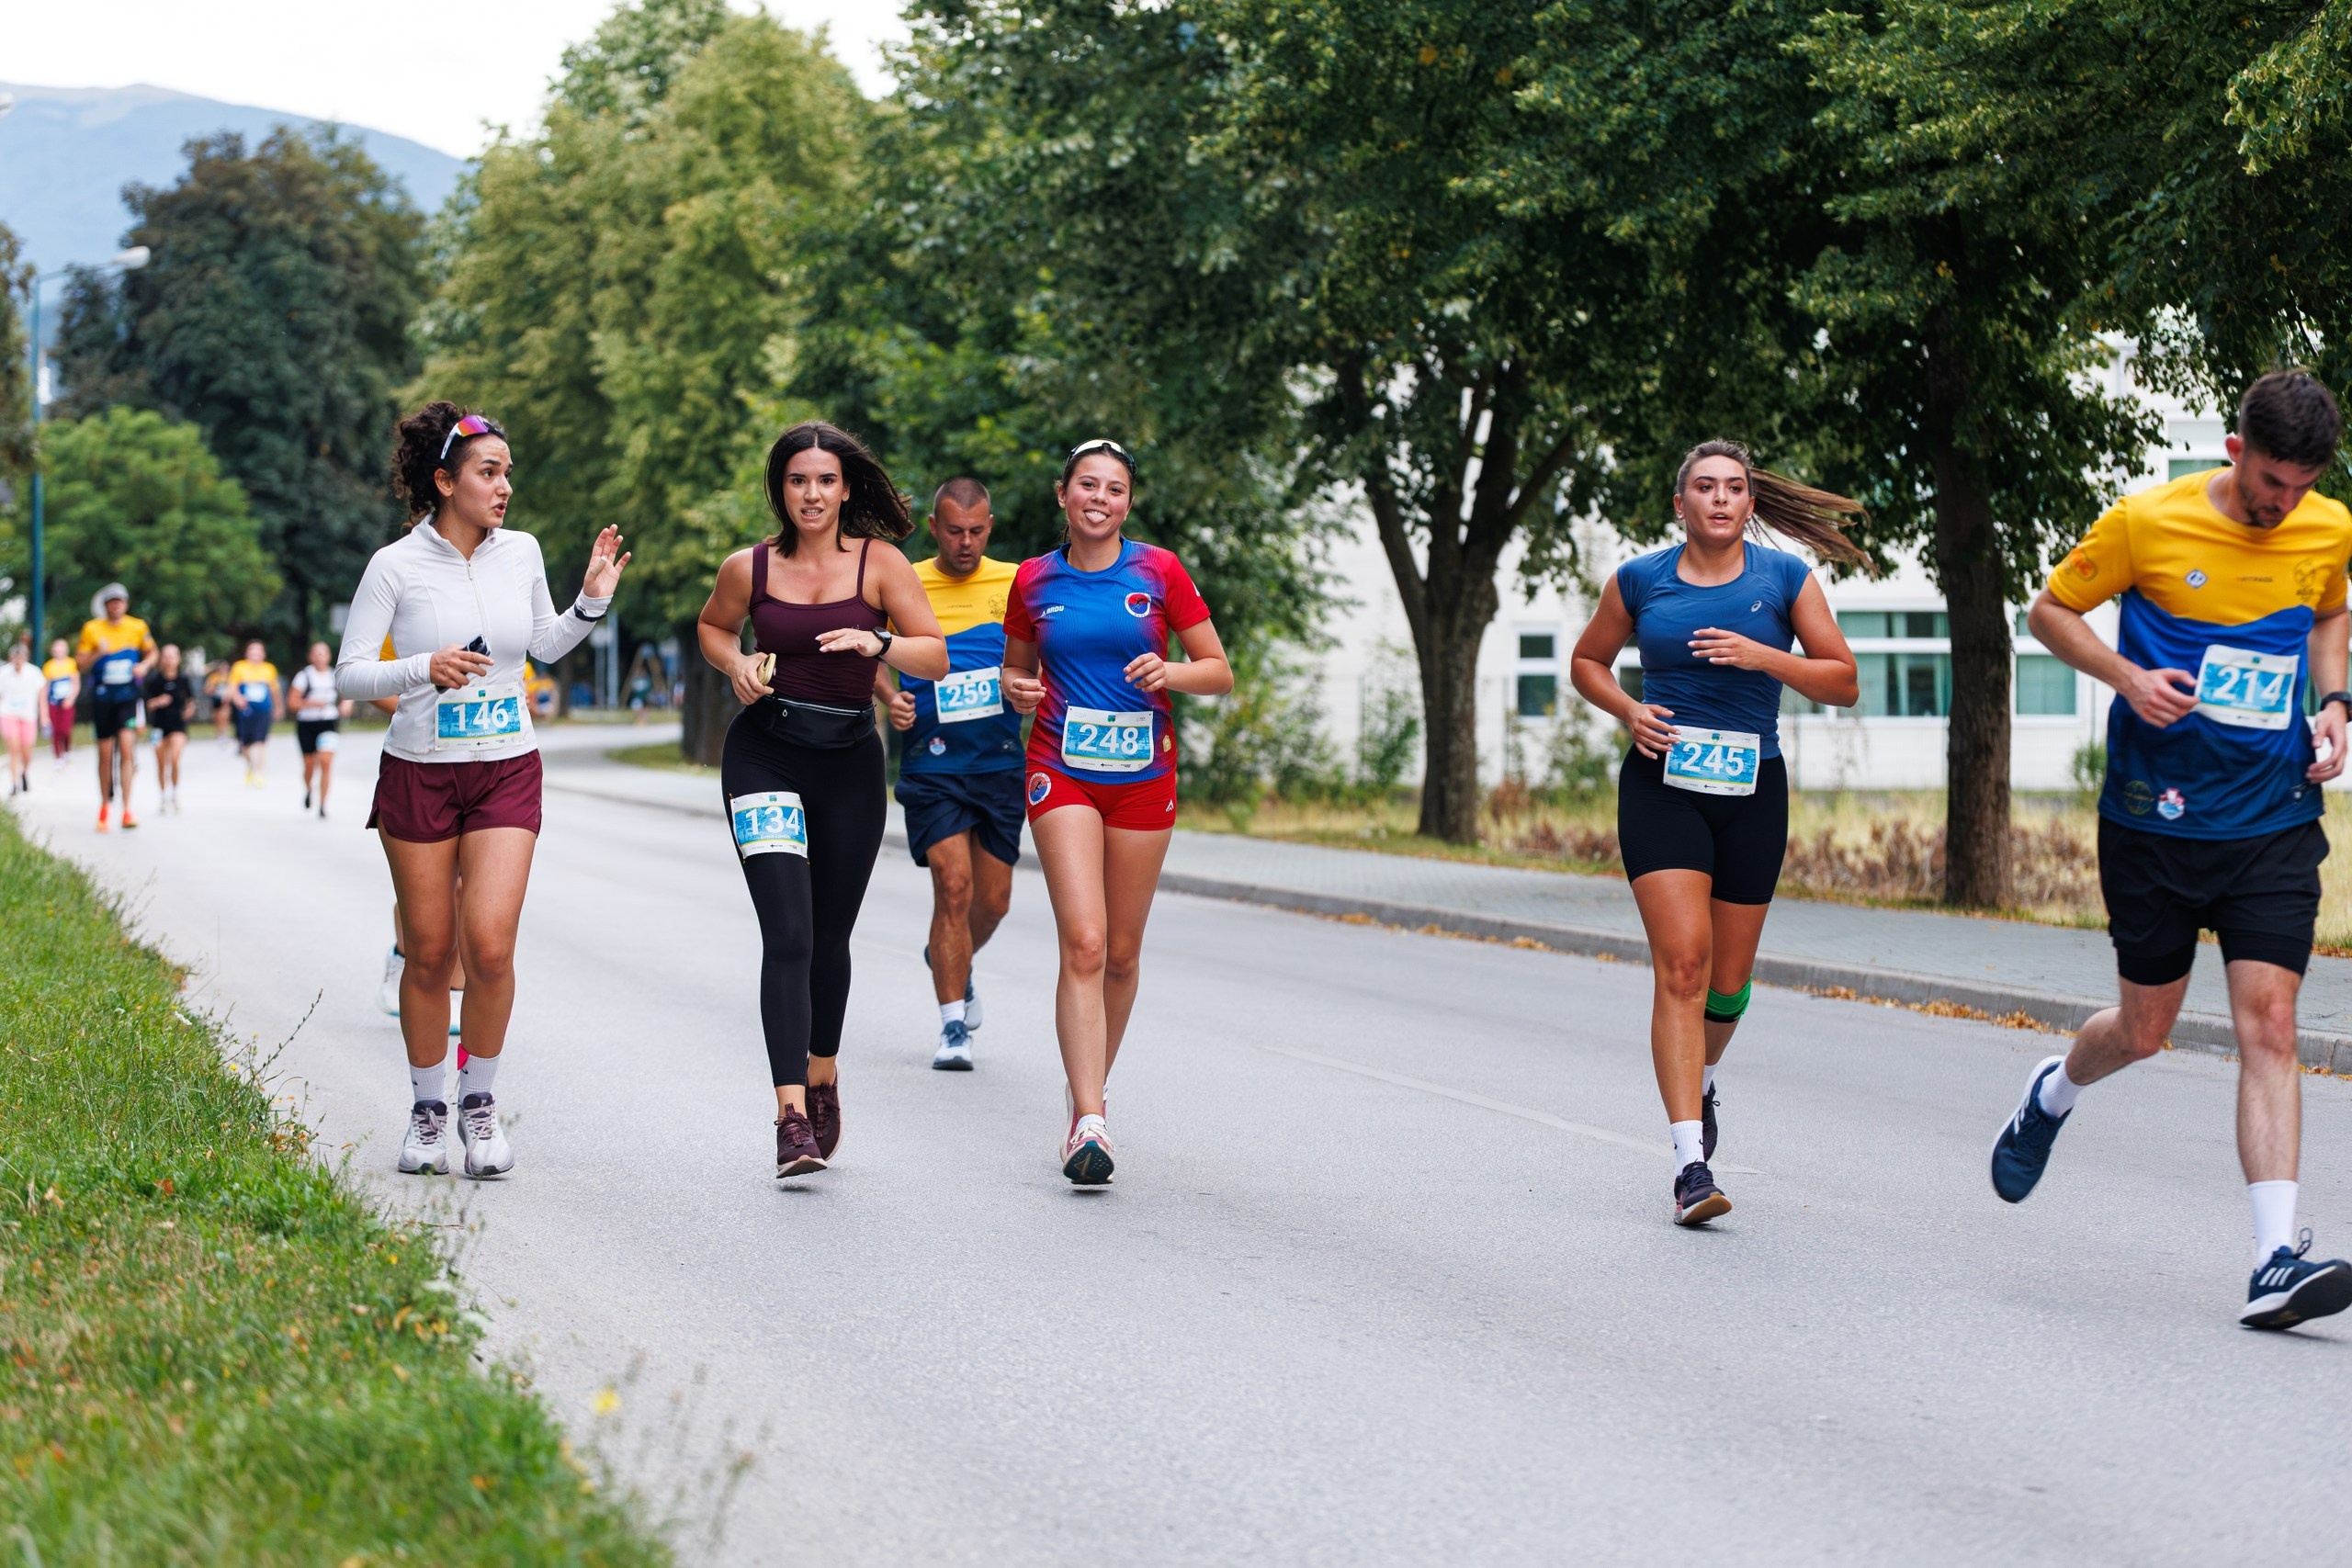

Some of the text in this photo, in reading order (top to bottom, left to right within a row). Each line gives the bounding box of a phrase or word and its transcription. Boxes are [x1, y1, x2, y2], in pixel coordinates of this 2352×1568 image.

[946, 680, 992, 707] 259
[2212, 666, 2285, 706] 214
[452, 699, 509, 731] 146
[1078, 724, 1139, 755] 248
[1680, 742, 1745, 776] 245
[745, 807, 801, 835] 134
